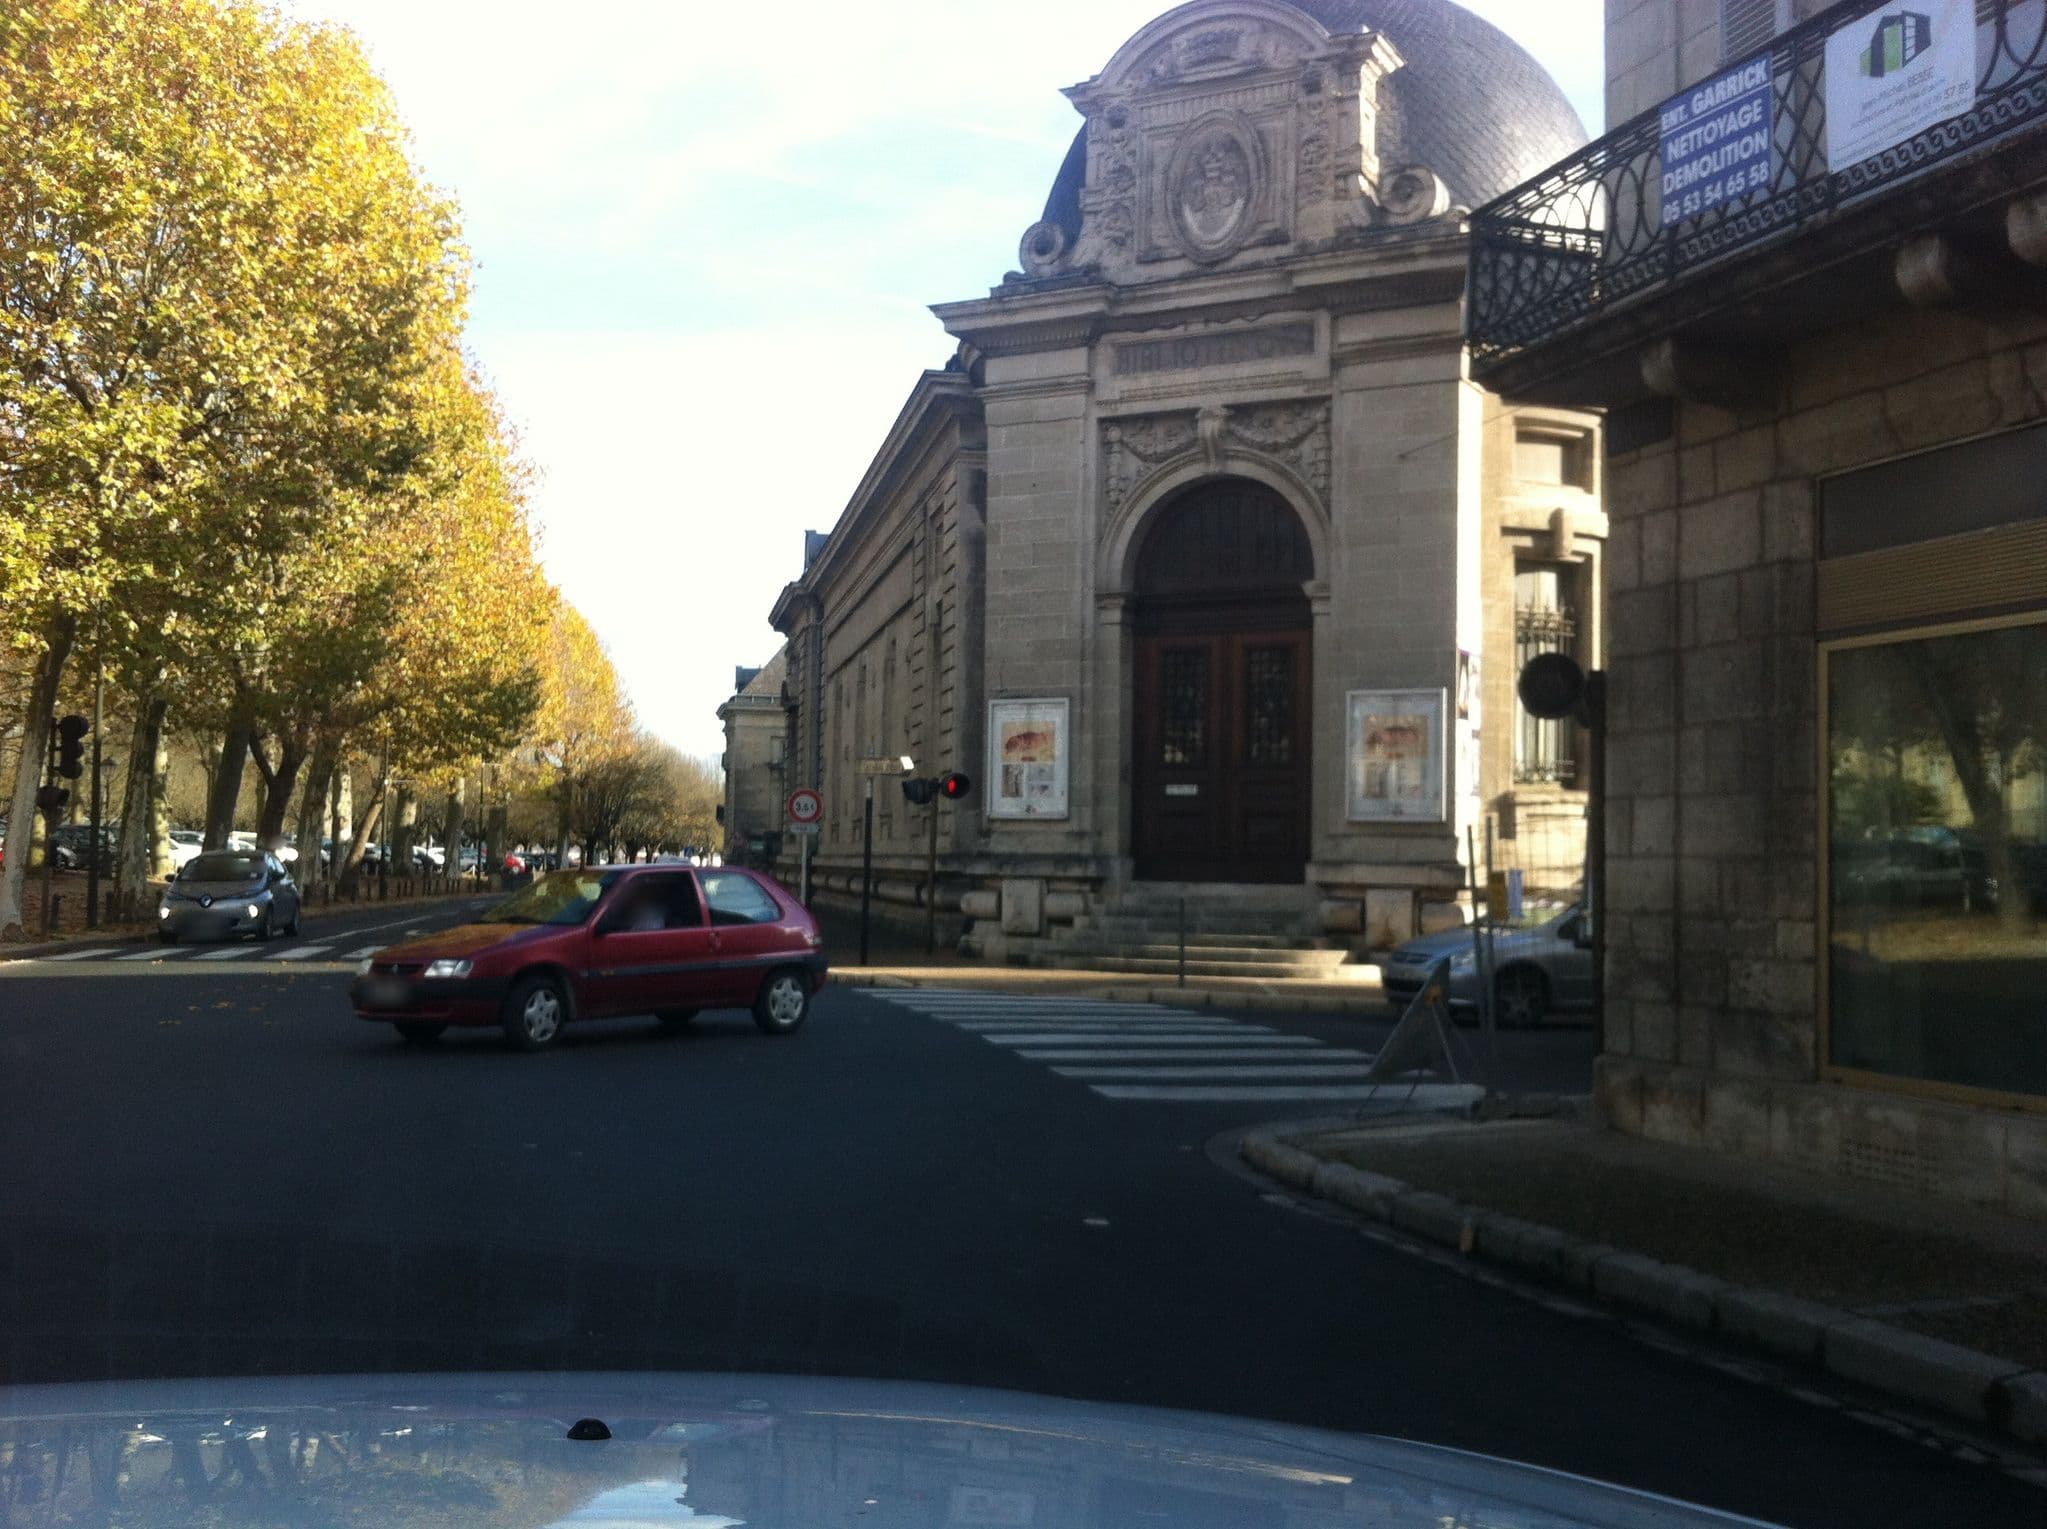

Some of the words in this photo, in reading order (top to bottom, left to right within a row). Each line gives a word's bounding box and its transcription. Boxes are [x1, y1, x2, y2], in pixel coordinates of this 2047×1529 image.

[1663, 127, 1768, 195] DEMOLITION
[1667, 98, 1762, 163] NETTOYAGE
[1663, 200, 1680, 224] 05
[1683, 191, 1700, 215] 53
[1704, 181, 1722, 205] 54
[1726, 171, 1745, 196] 65
[1749, 160, 1769, 186] 58
